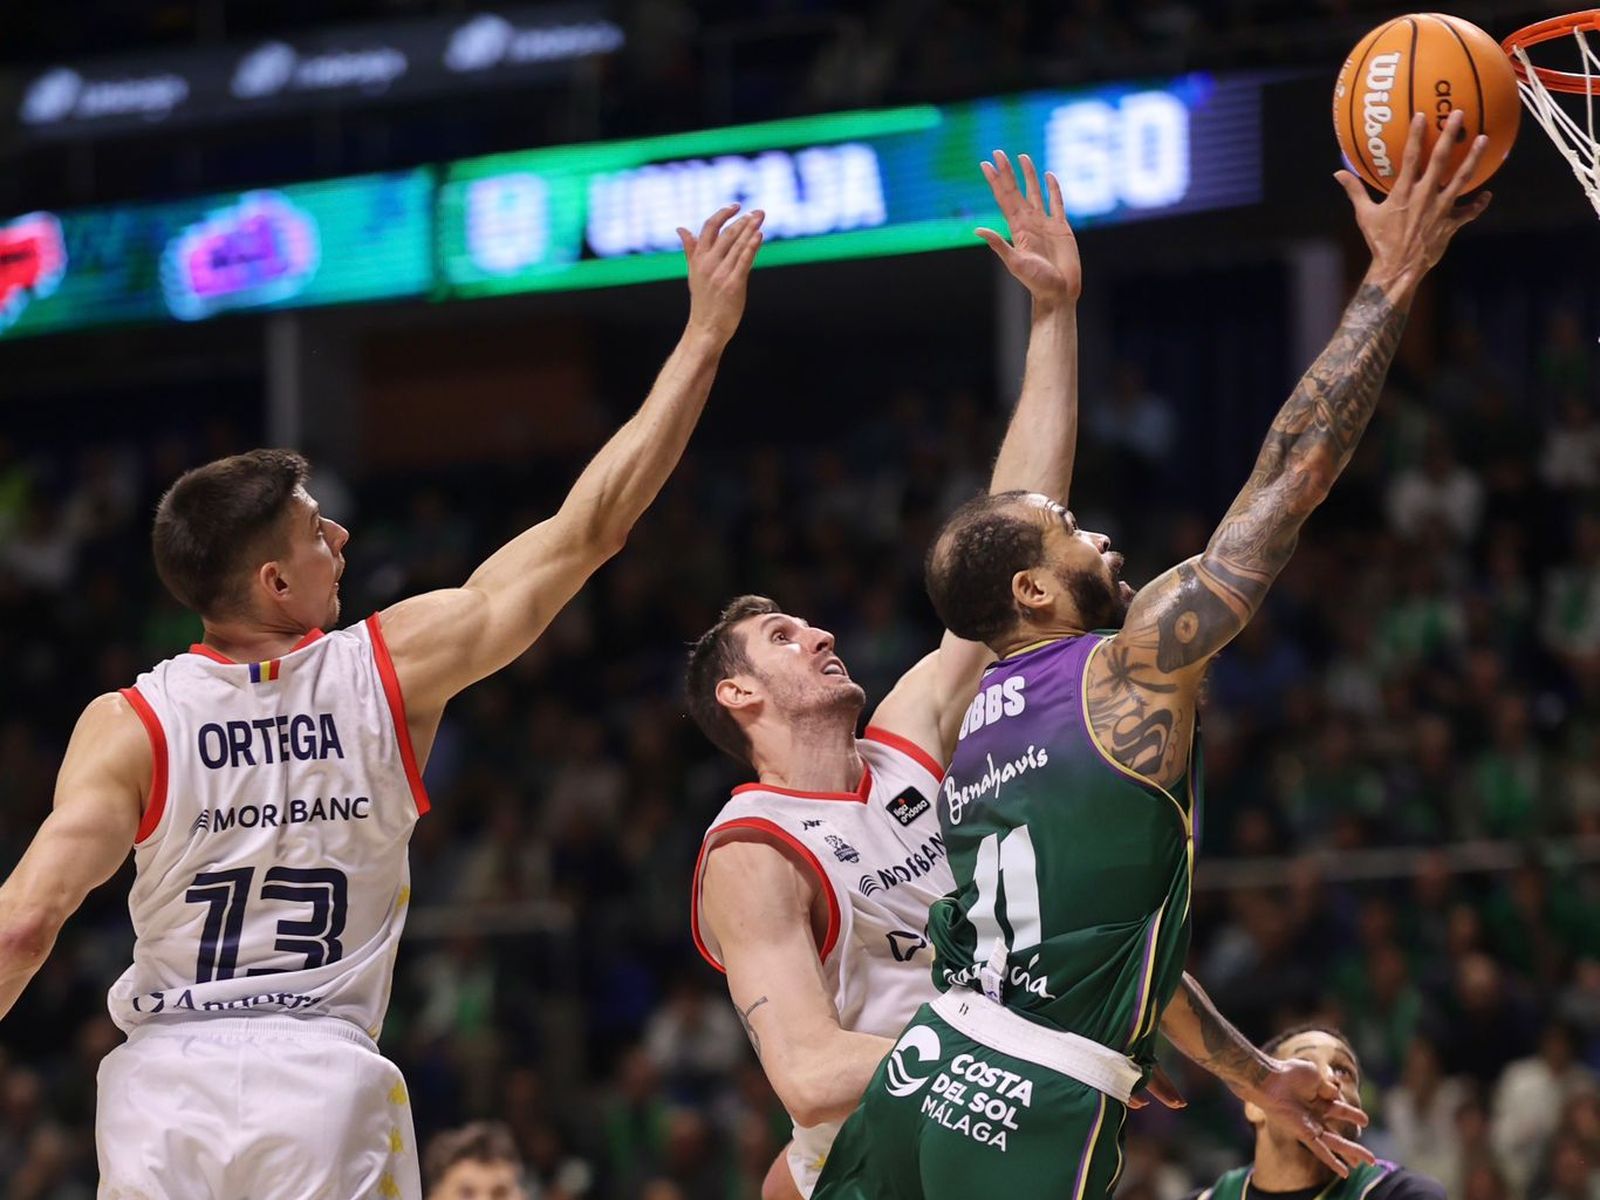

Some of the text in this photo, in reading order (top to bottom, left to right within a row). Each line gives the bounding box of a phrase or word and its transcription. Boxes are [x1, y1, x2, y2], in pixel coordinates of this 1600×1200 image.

[1363, 51, 1401, 177] Wilson
[198, 713, 344, 769] ORTEGA
[966, 823, 1042, 963] 11
[185, 865, 348, 985] 13
[930, 1072, 1019, 1131] DEL SOL
[950, 1053, 1034, 1108] COSTA
[920, 1094, 1007, 1153] MÁLAGA
